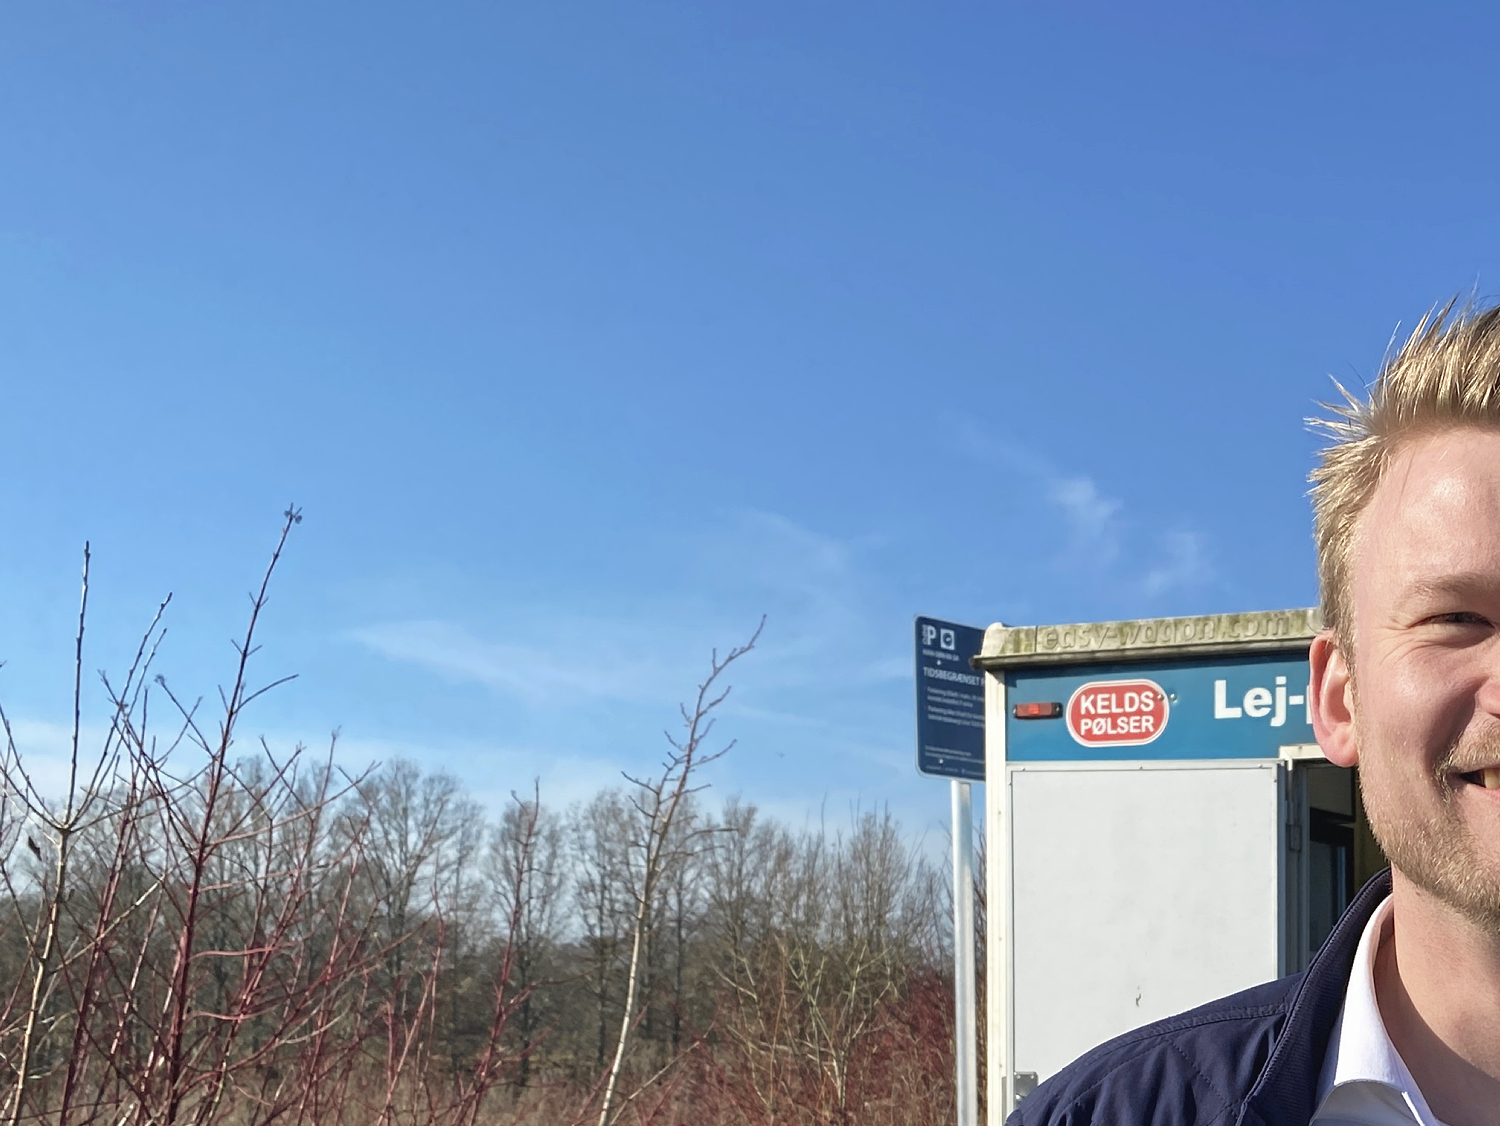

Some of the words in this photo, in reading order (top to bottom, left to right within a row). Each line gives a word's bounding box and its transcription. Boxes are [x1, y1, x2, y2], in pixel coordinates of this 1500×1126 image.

[927, 624, 936, 645] P
[1041, 611, 1291, 650] easy-wagon.com
[1079, 690, 1154, 716] KELDS
[1213, 675, 1311, 728] Lej-
[1079, 714, 1155, 737] PØLSER
